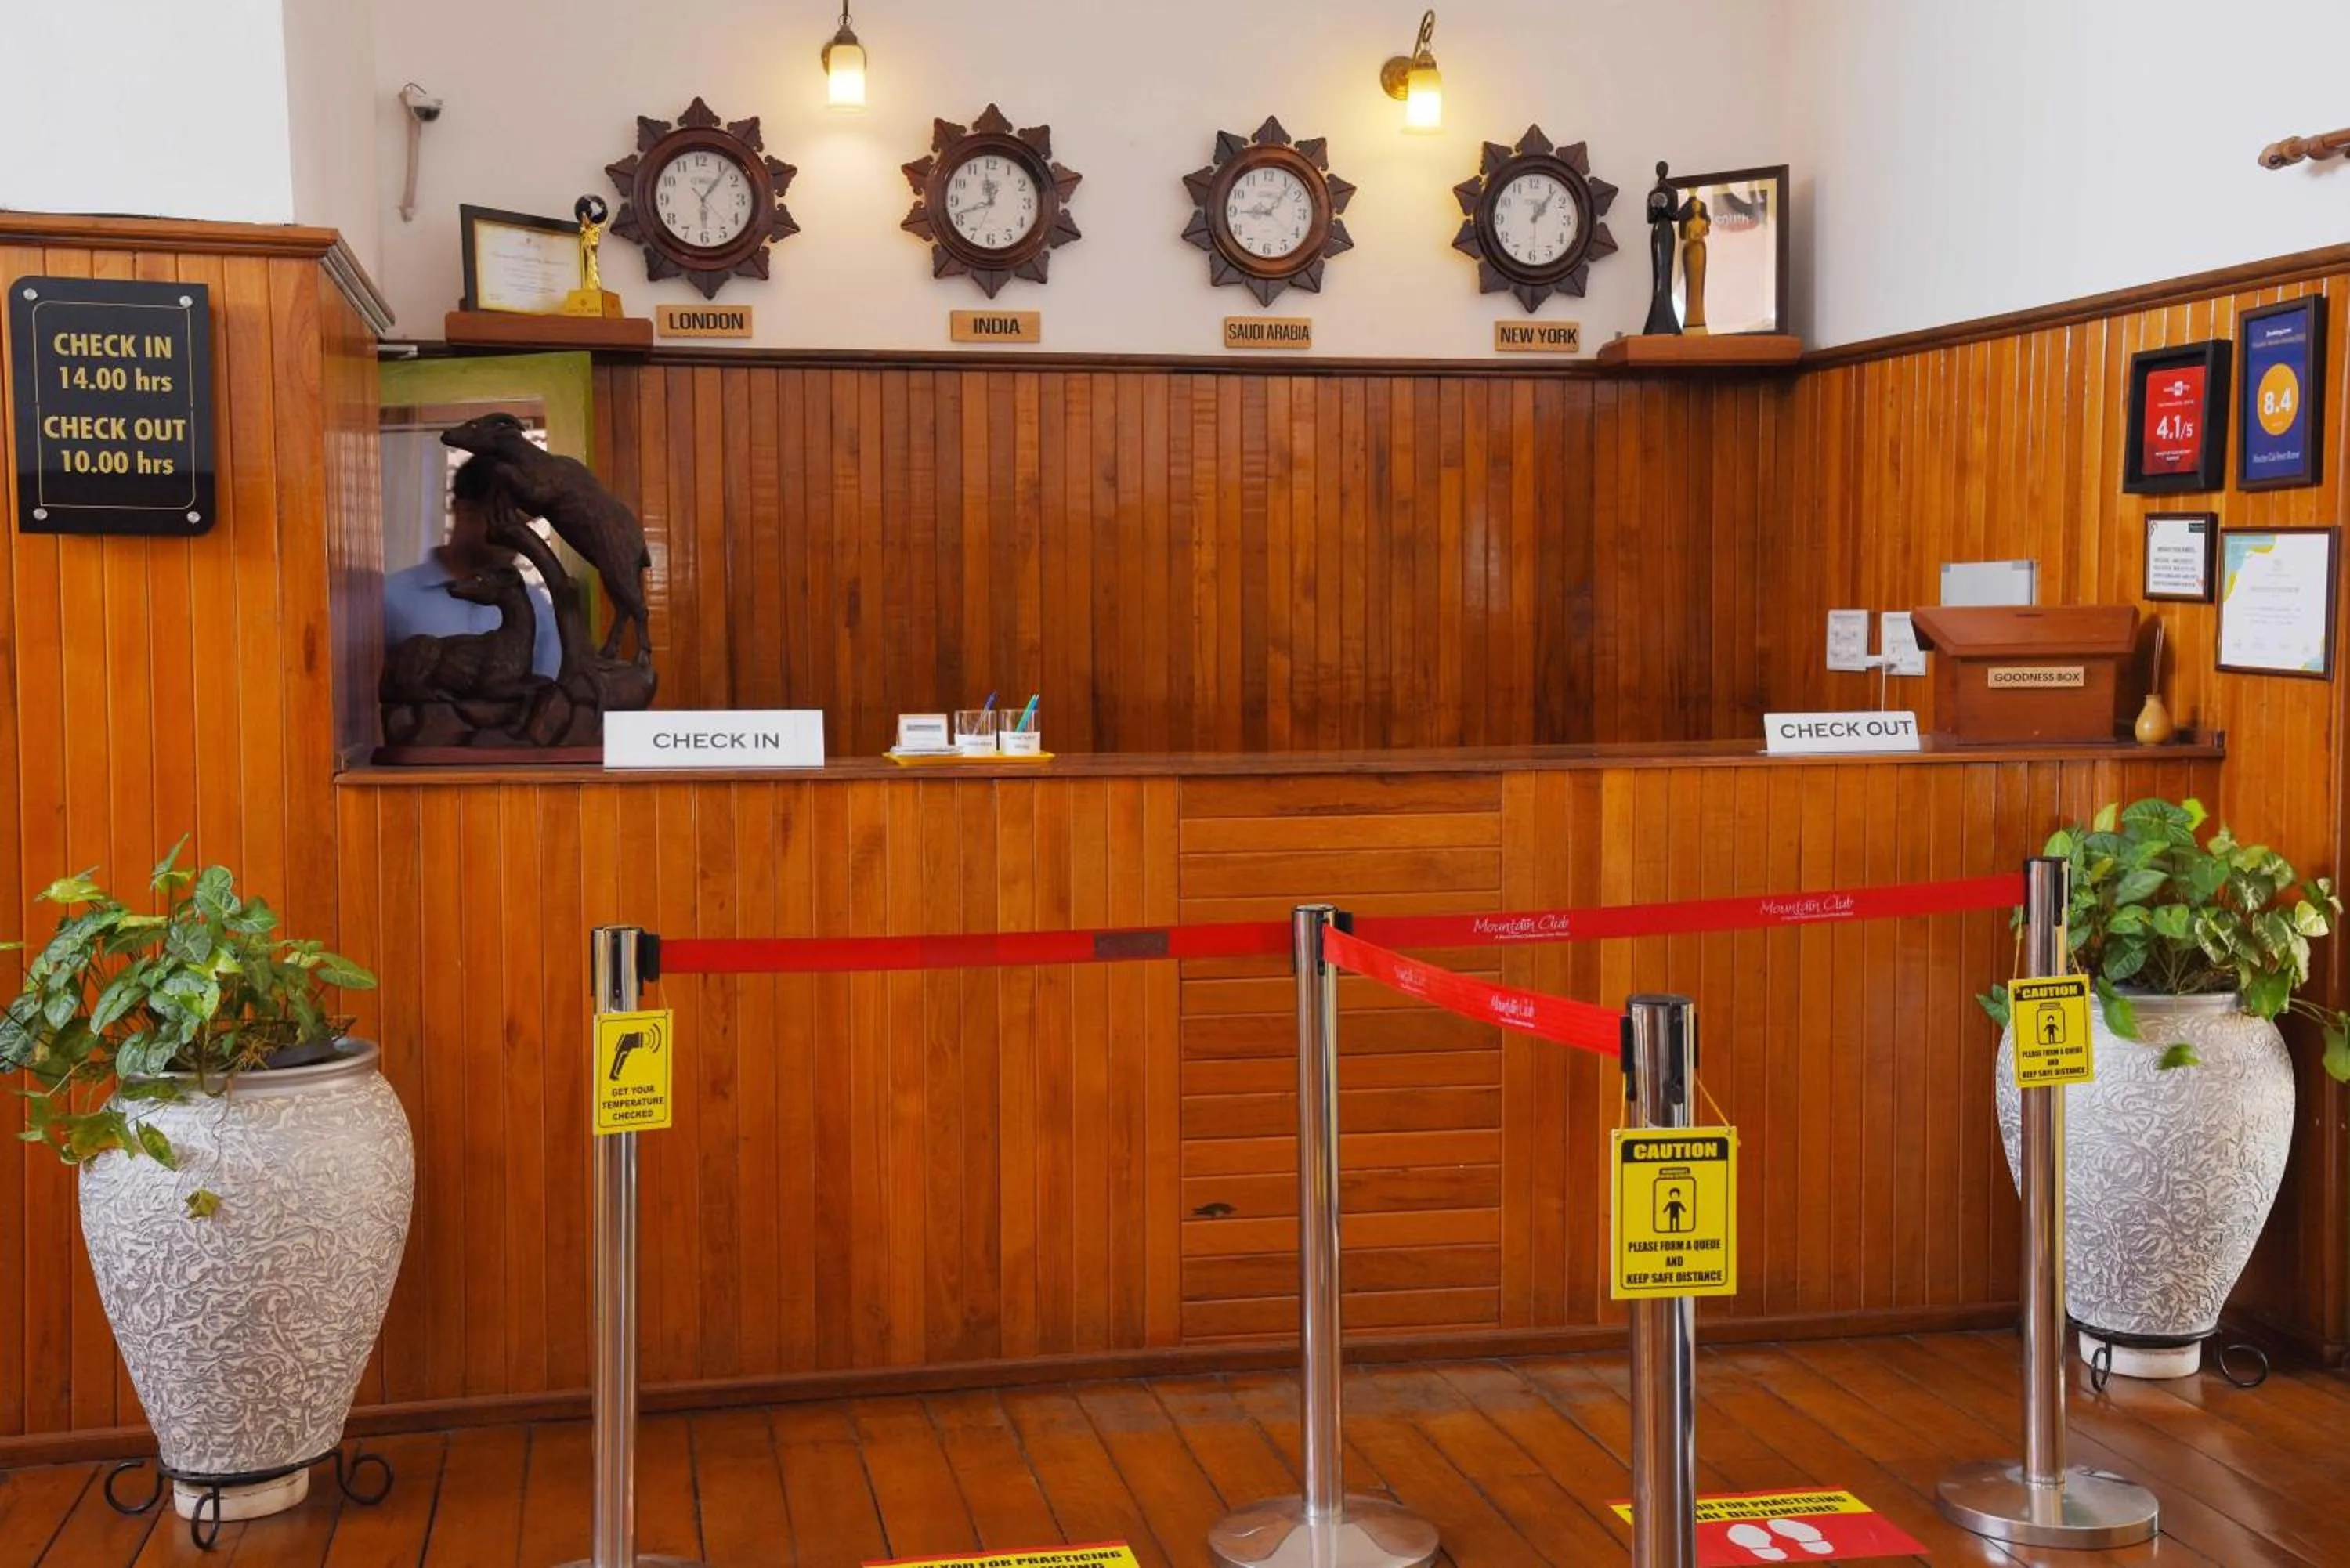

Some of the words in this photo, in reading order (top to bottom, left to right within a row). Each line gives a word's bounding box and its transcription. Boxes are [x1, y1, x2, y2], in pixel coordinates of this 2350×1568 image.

[677, 161, 687, 172] 11
[696, 156, 707, 167] 12
[985, 159, 997, 170] 12
[967, 164, 978, 175] 11
[663, 176, 676, 186] 10
[730, 175, 739, 186] 2
[1246, 175, 1256, 186] 11
[1263, 170, 1274, 182] 12
[954, 179, 966, 189] 10
[1018, 179, 1026, 191] 2
[1512, 183, 1522, 195] 11
[1528, 178, 1540, 189] 12
[660, 194, 669, 205] 9
[736, 193, 745, 206] 3
[1234, 189, 1245, 199] 10
[1293, 191, 1302, 202] 2
[950, 196, 959, 208] 9
[1023, 197, 1032, 209] 3
[1500, 197, 1511, 209] 10
[1558, 197, 1567, 210] 2
[1228, 207, 1238, 218] 9
[1298, 208, 1307, 221] 3
[667, 213, 676, 225] 8
[732, 213, 739, 226] 4
[956, 213, 964, 226] 8
[1017, 216, 1025, 229] 4
[1495, 213, 1504, 225] 9
[1563, 215, 1571, 227] 3
[682, 226, 689, 239] 7
[719, 226, 728, 239] 5
[970, 228, 978, 240] 7
[1004, 230, 1013, 242] 5
[1234, 224, 1242, 236] 8
[1291, 226, 1300, 238] 4
[700, 232, 710, 244] 6
[986, 233, 995, 245] 6
[1246, 238, 1254, 250] 7
[1262, 243, 1271, 255] 6
[1279, 240, 1288, 251] 5
[1528, 251, 1537, 262] 6
[668, 313, 744, 330] LONDON
[973, 317, 1021, 334] INDIA
[1228, 323, 1264, 340] SAUDI
[1267, 325, 1310, 341] ARABIA
[1500, 327, 1534, 344] NEW
[1538, 328, 1577, 344] YORK
[53, 333, 136, 357] CHECK
[145, 336, 172, 358] IN
[60, 367, 127, 390] 14.00
[135, 368, 172, 392] hrs
[2263, 388, 2292, 416] 8.4
[44, 416, 128, 440] CHECK
[134, 418, 186, 441] OUT
[2156, 414, 2193, 439] 4.1/5
[62, 450, 128, 473] 10.00
[137, 451, 174, 475] hrs
[1994, 673, 2054, 682] GOODNESS
[2056, 673, 2080, 682] BOX
[1781, 721, 1860, 739] CHECK
[1867, 720, 1912, 735] OUT
[653, 733, 746, 749] CHECK
[754, 733, 779, 749] IN
[1760, 898, 1820, 916] Mountain
[1824, 894, 1854, 911] Club
[1473, 917, 1535, 934] Mountain
[1538, 914, 1570, 930] Club
[2022, 985, 2078, 999] CAUTION
[612, 1087, 627, 1097] GET
[632, 1086, 655, 1094] YOUR
[602, 1097, 665, 1110] TEMPERATURE
[613, 1110, 653, 1121] CHECKED
[1633, 1142, 1718, 1160] CAUTION
[1628, 1241, 1659, 1253] PLEASE
[1661, 1240, 1684, 1251] FORM
[1686, 1240, 1692, 1250] A
[1694, 1238, 1721, 1251] QUEUE
[1665, 1255, 1683, 1267] AND
[1626, 1273, 1648, 1284] KEEP
[1651, 1271, 1674, 1284] SAFE
[1676, 1270, 1723, 1283] DISTANCE
[1717, 1501, 1748, 1510] FOR
[1750, 1494, 1848, 1508] PRACTICING
[1726, 1505, 1839, 1518] DISTANCING
[1016, 1550, 1122, 1565] PRACTICING
